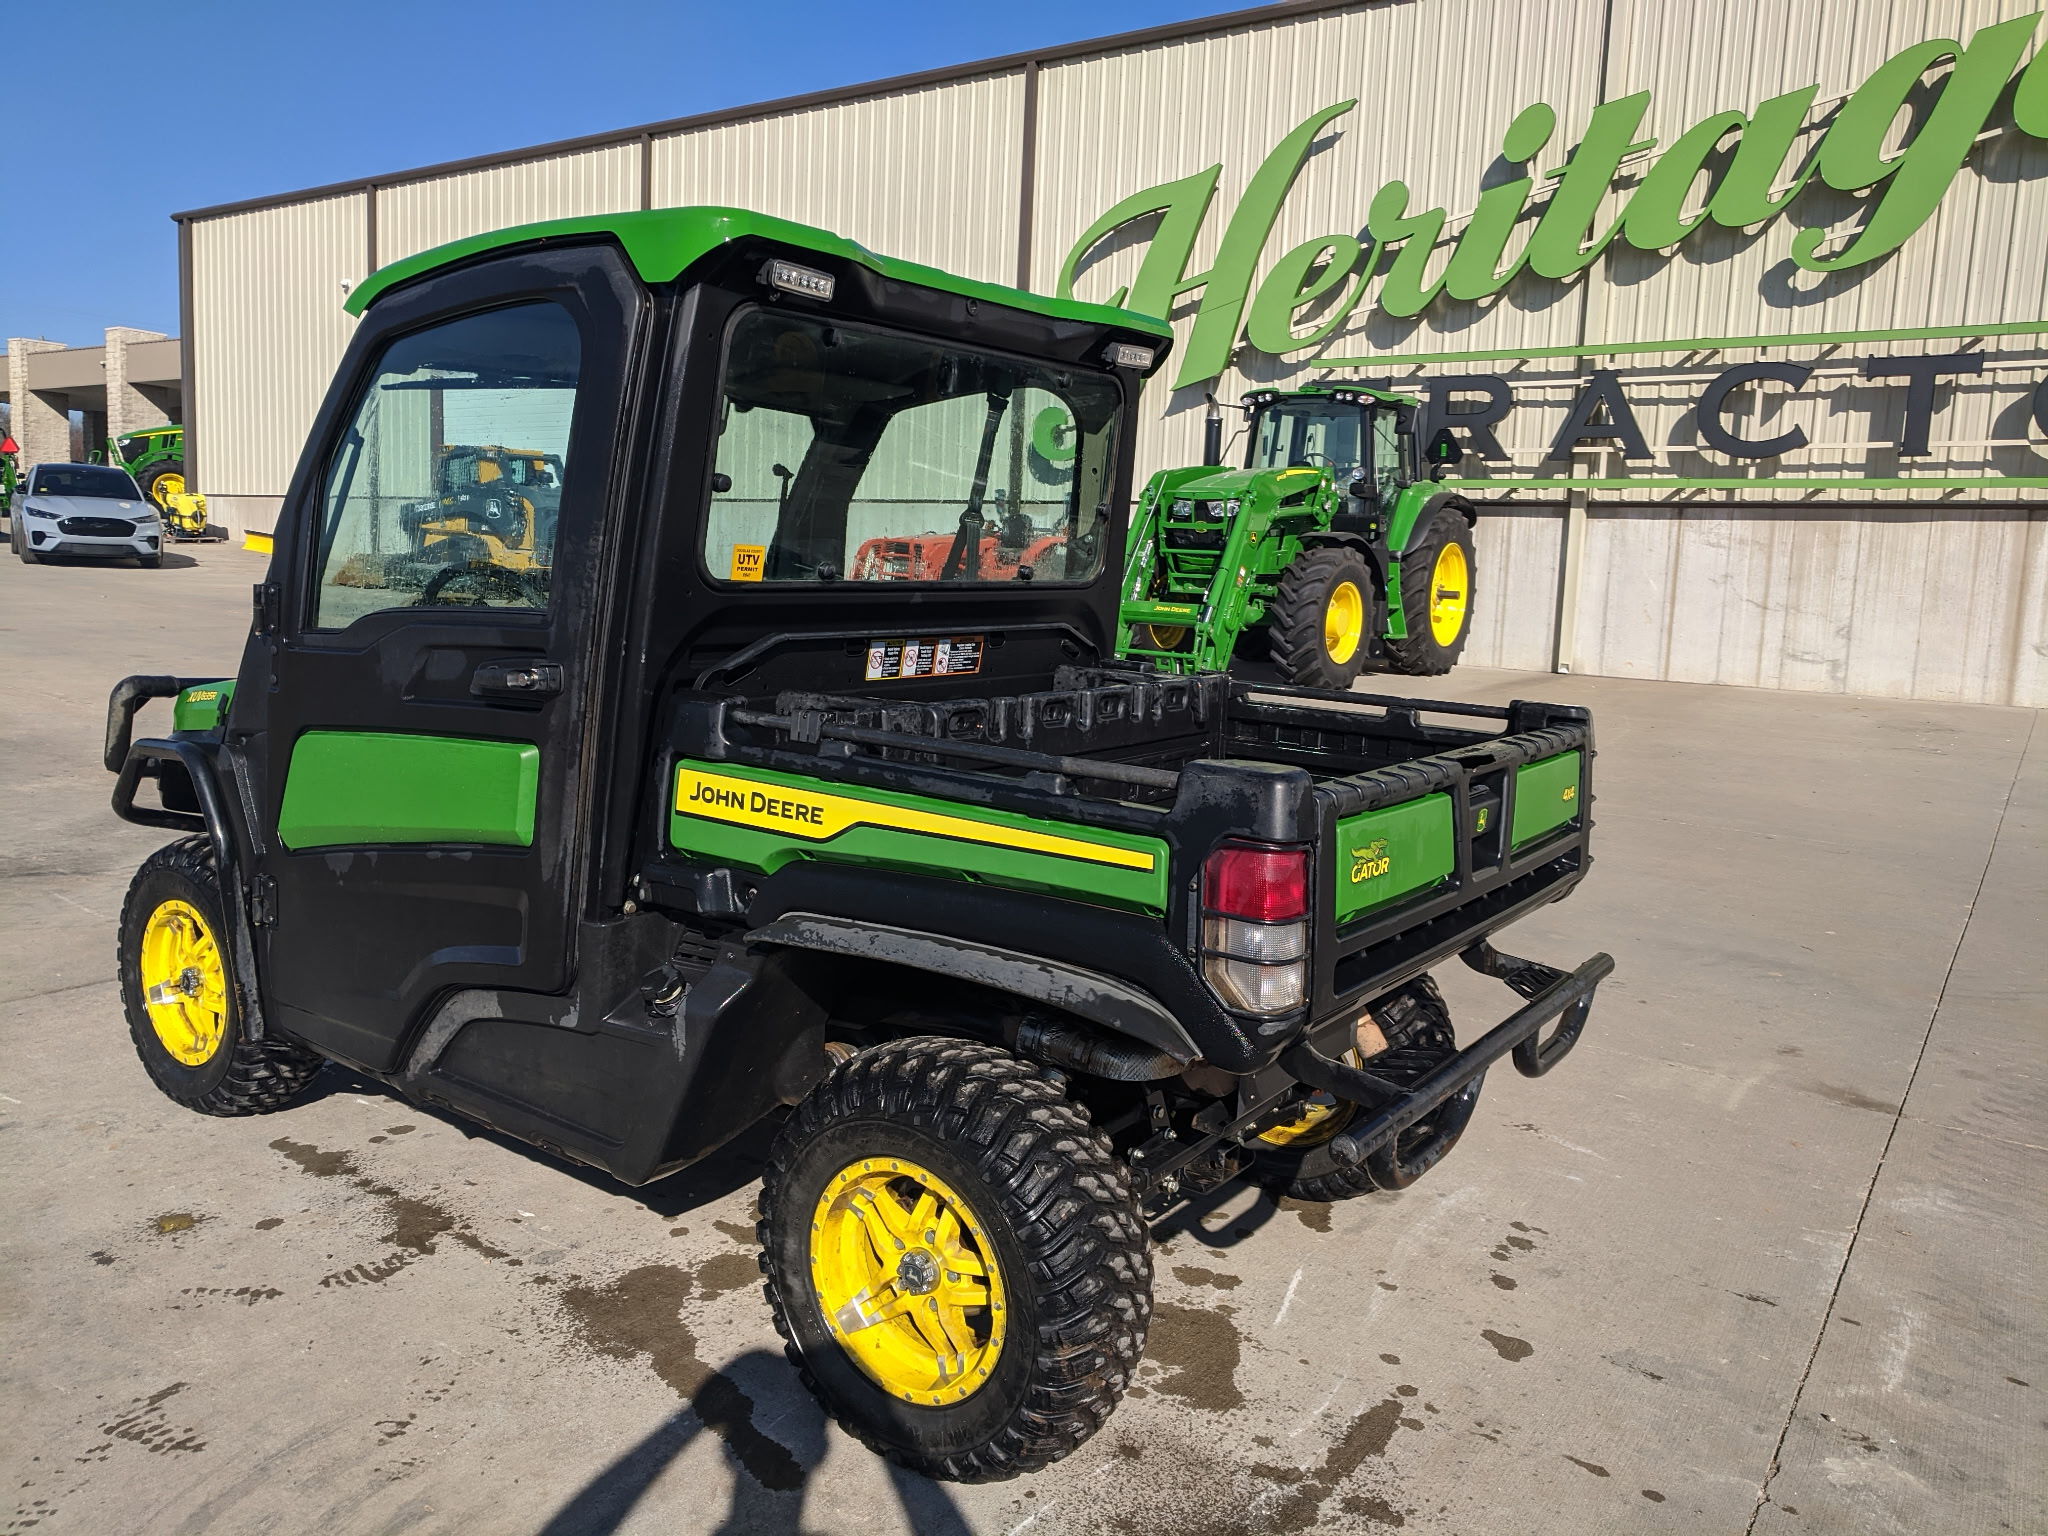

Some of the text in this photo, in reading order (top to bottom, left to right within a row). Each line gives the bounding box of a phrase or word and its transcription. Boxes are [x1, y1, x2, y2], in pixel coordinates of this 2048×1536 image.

[1056, 10, 2048, 392] Heritag
[1312, 349, 2048, 462] RACT
[737, 553, 760, 565] UTV
[689, 781, 825, 825] JOHN DEERE
[1351, 856, 1390, 884] GATOR
